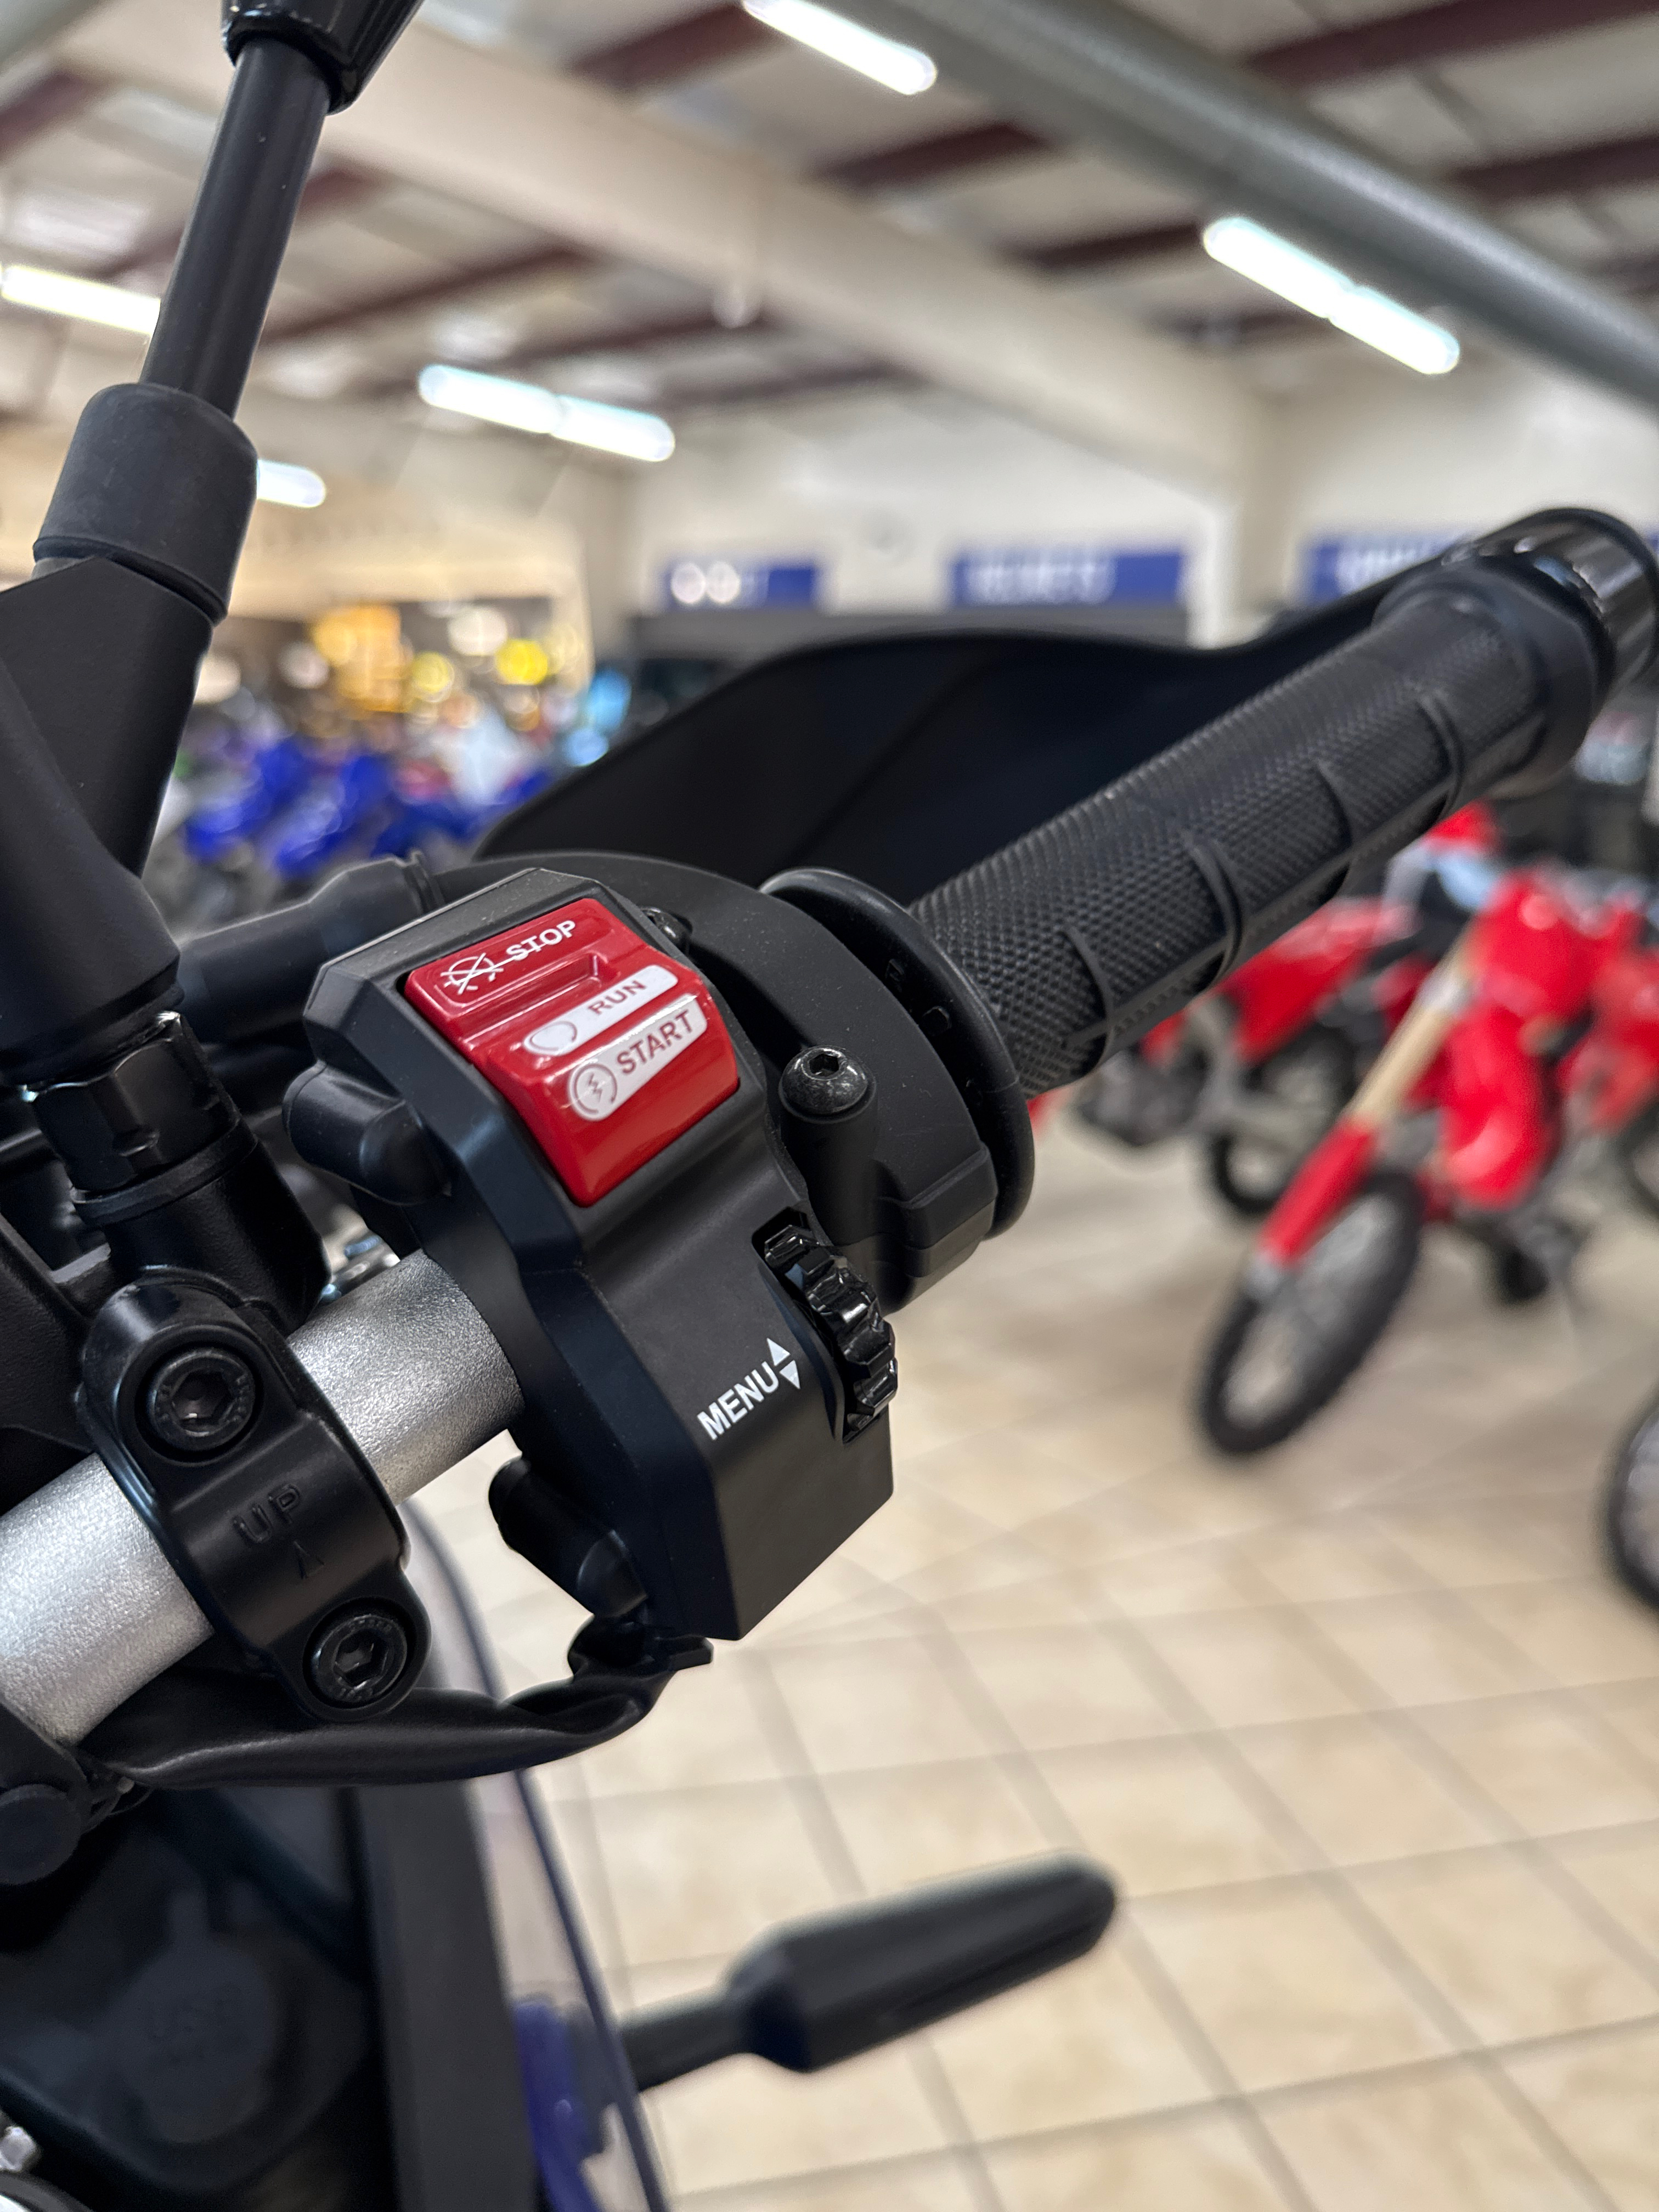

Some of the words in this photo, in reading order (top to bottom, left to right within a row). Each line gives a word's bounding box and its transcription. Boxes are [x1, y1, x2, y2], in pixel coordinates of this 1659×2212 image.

[507, 920, 576, 962] STOP
[588, 980, 646, 1016] RUN
[616, 1010, 695, 1076] START
[697, 1361, 779, 1441] MENU
[232, 1483, 302, 1545] UP
